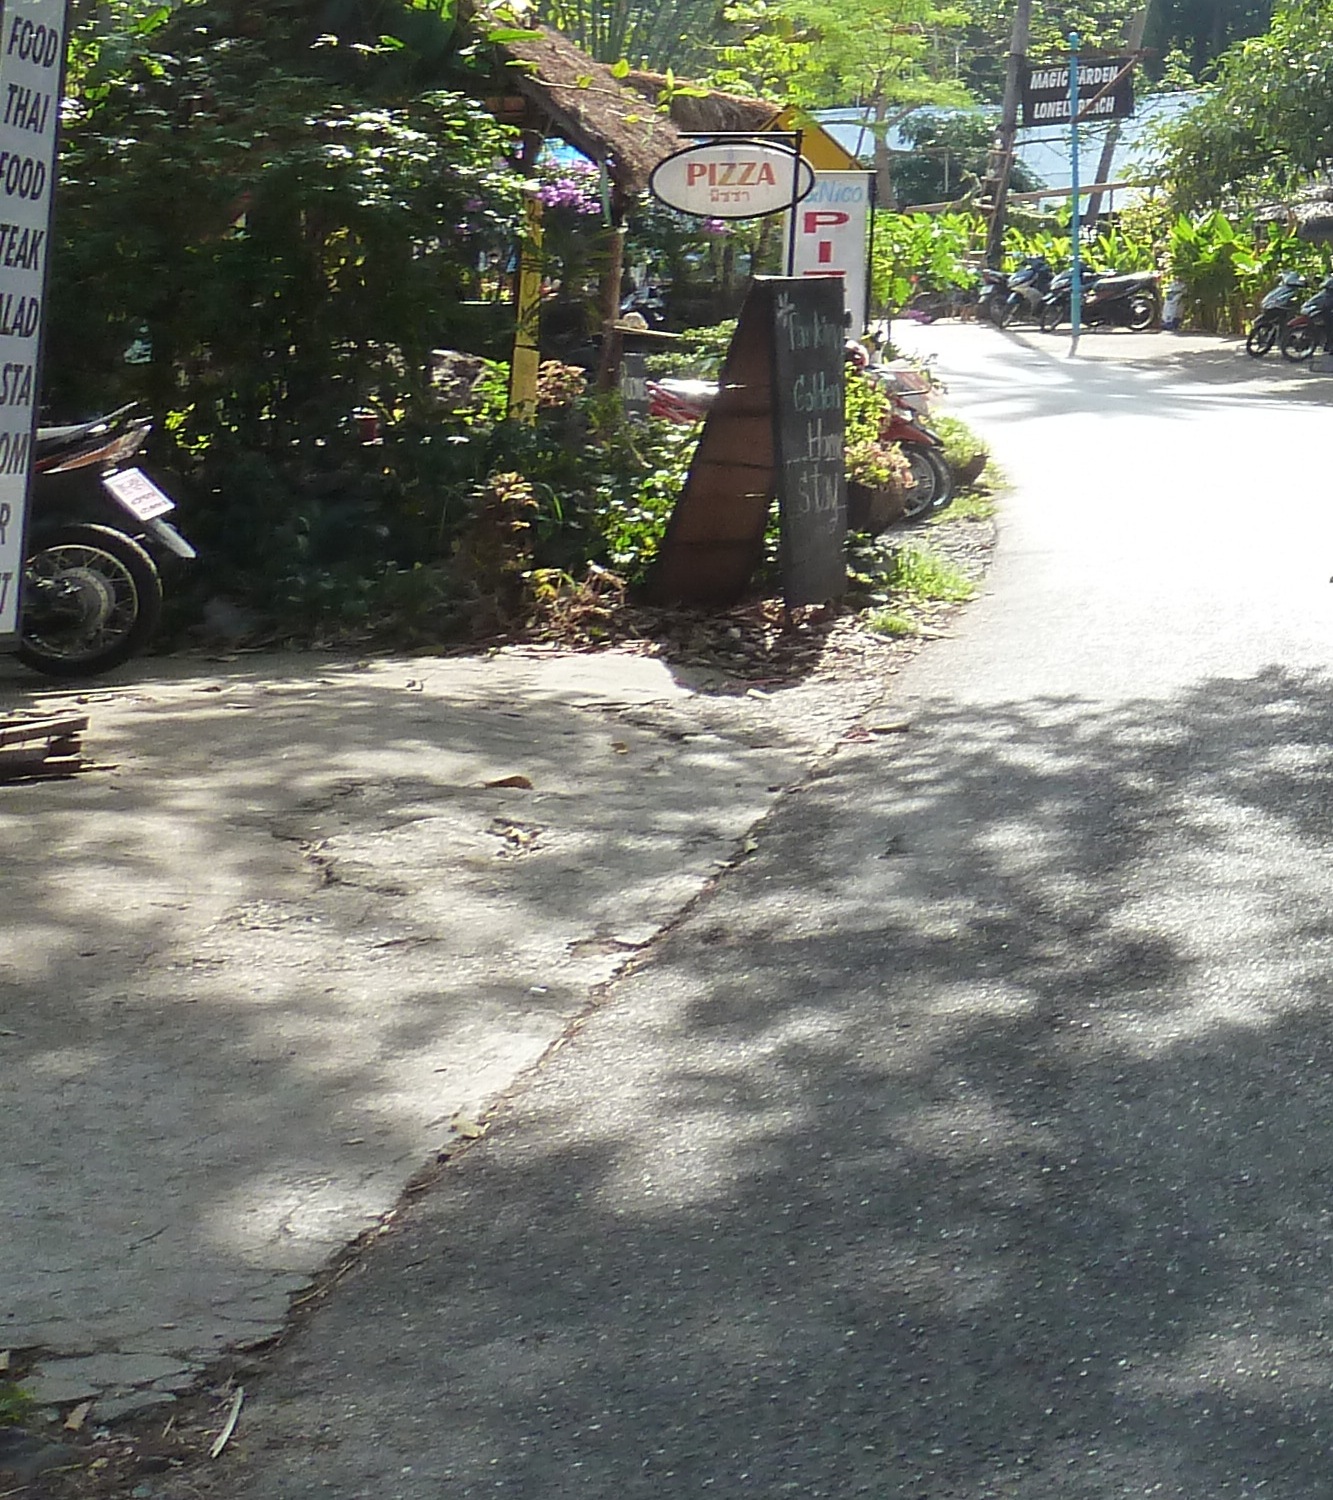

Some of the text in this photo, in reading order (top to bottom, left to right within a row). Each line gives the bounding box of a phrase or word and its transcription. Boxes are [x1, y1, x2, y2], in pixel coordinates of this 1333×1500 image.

[7, 16, 58, 68] FOOD
[1029, 70, 1069, 90] MAGIC
[3, 83, 51, 134] THAI
[686, 162, 775, 186] PIZZA
